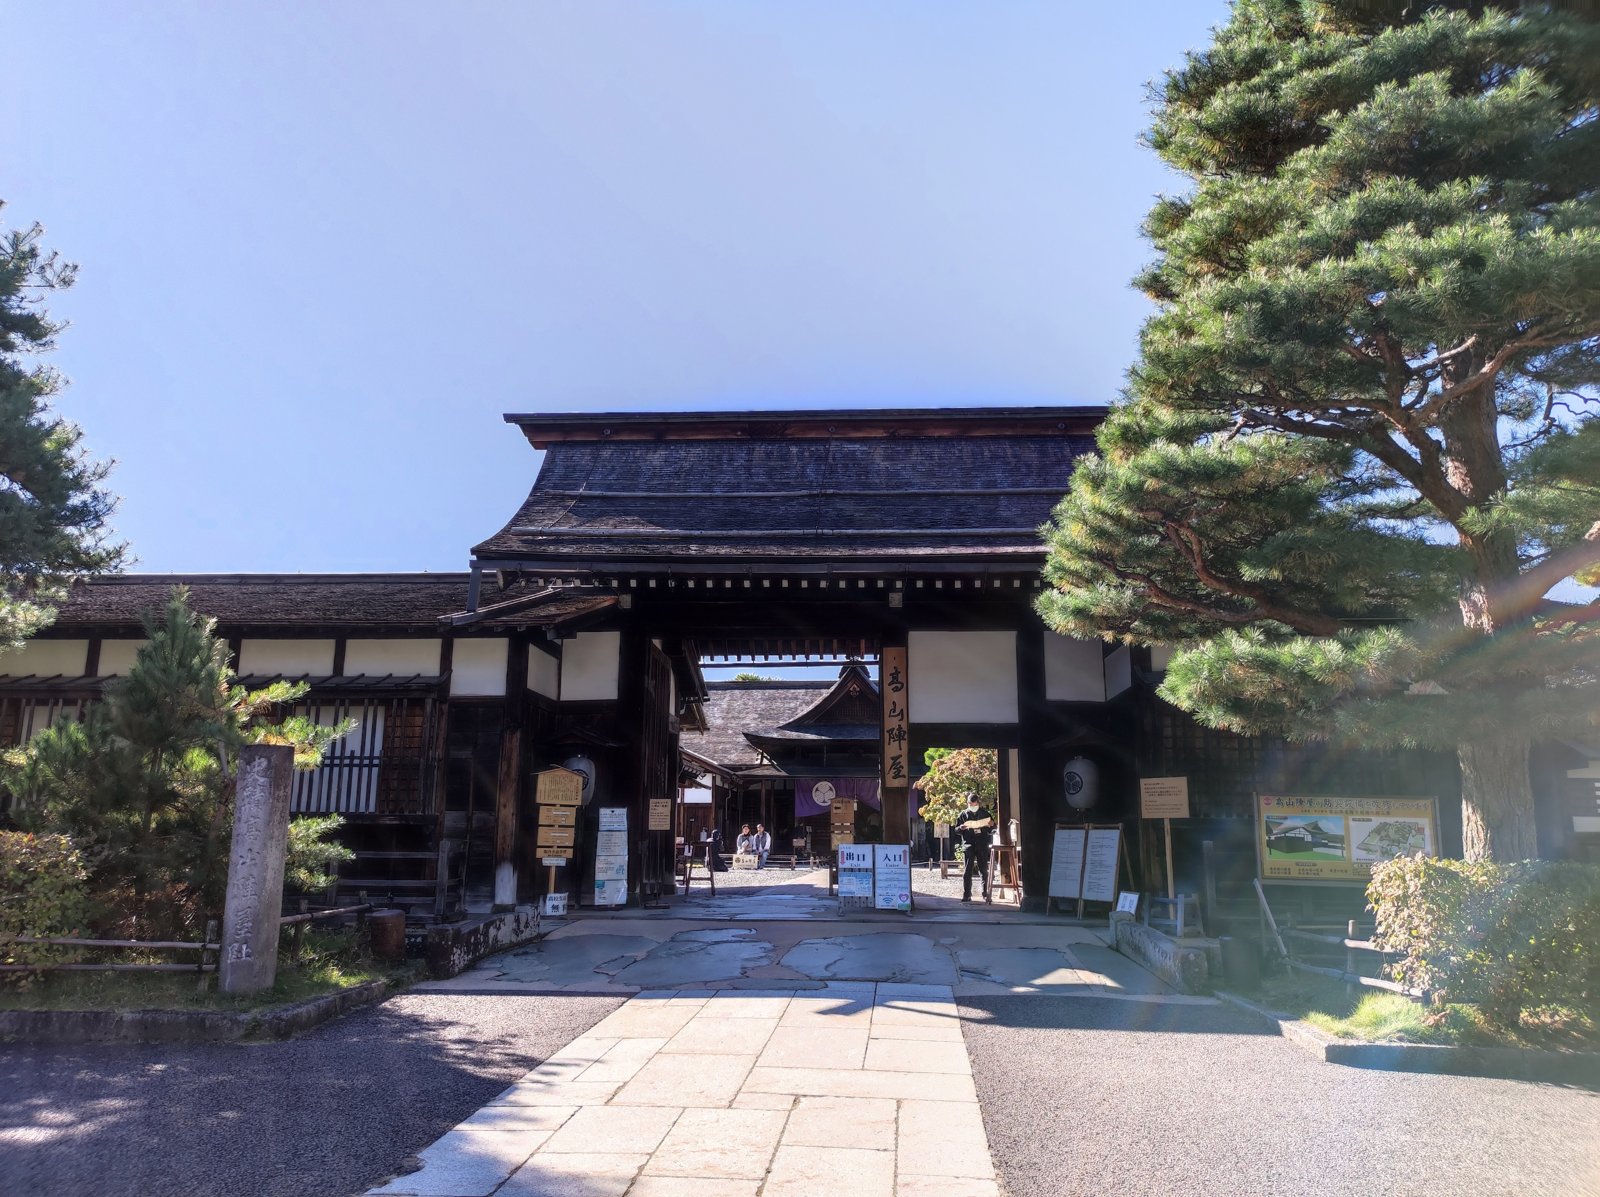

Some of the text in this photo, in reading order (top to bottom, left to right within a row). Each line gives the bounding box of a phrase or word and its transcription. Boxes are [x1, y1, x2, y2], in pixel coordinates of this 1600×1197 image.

[886, 666, 907, 780] 高山陣屋
[845, 852, 865, 862] 出口
[883, 853, 902, 862] 入口
